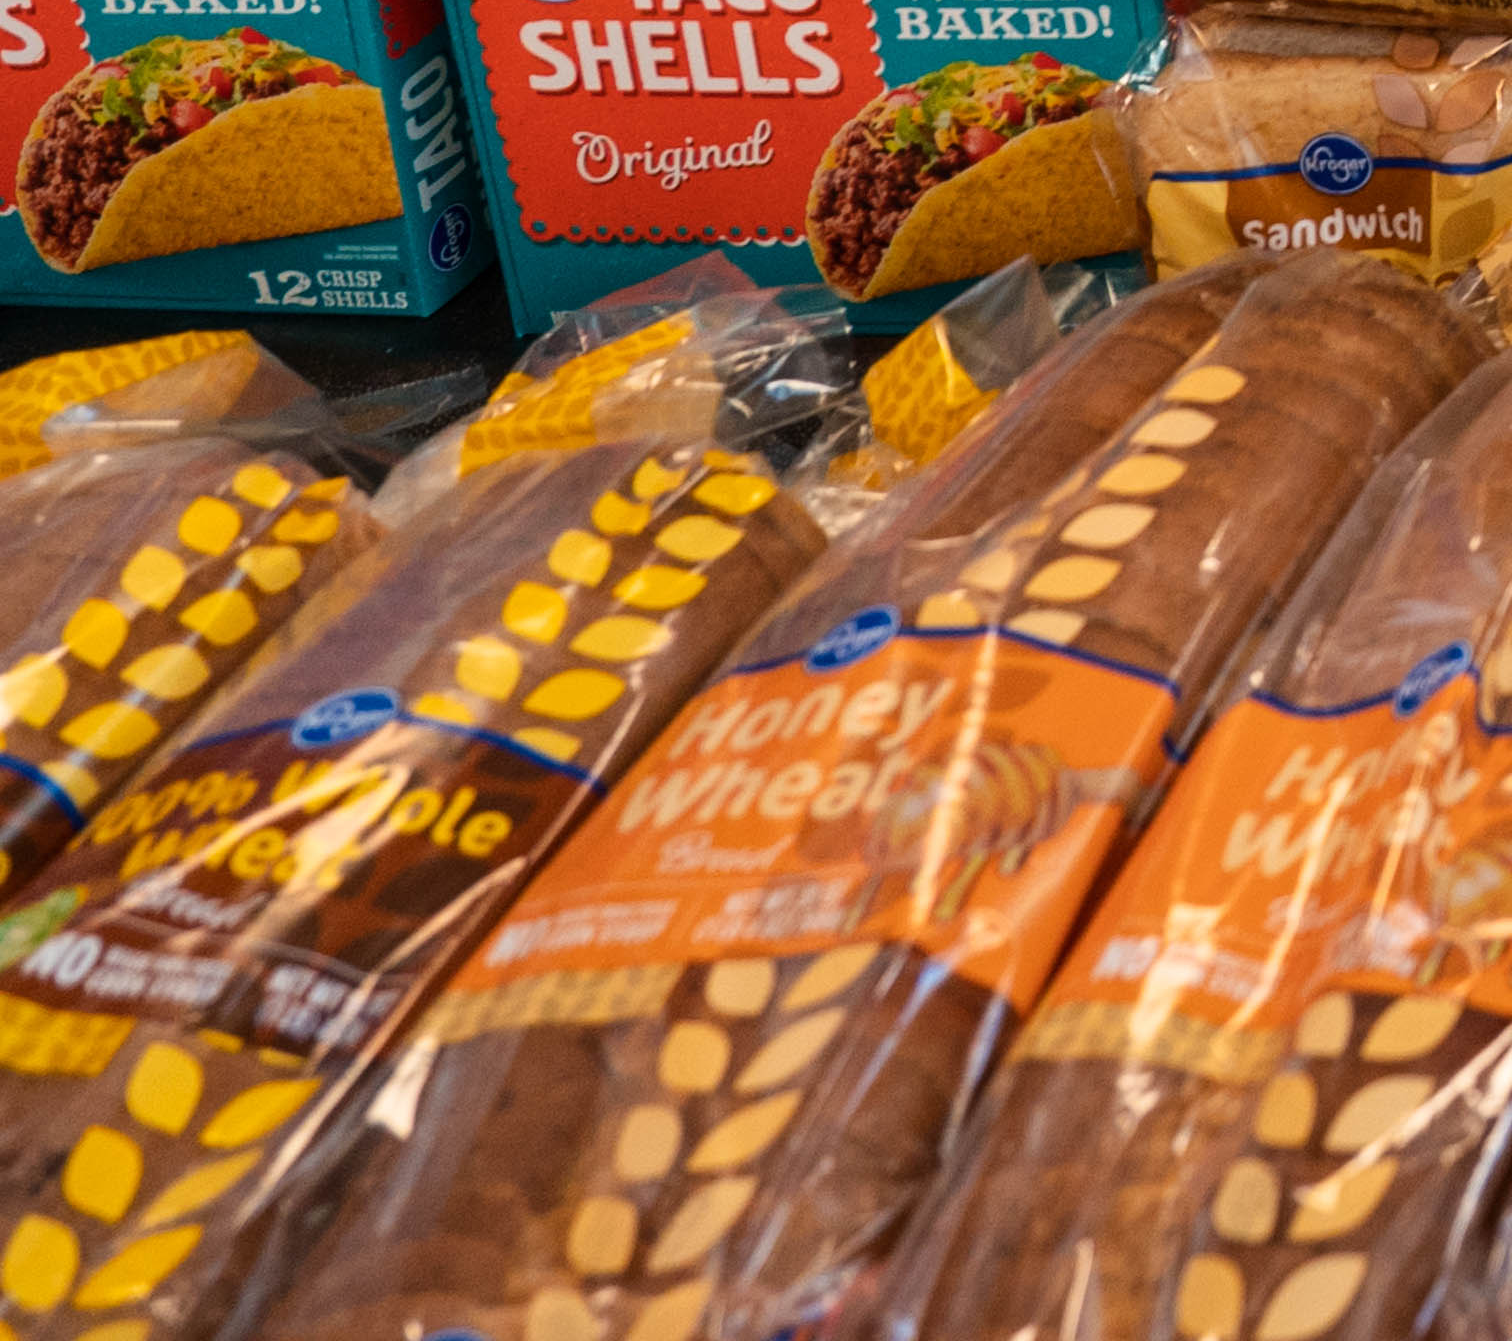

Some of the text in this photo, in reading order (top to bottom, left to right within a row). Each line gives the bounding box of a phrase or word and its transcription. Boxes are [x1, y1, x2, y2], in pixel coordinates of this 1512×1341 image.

[519, 19, 841, 96] SHELLS
[896, 7, 1113, 41] BAKED!
[572, 121, 774, 189] Original
[248, 269, 383, 306] 12 CRISP
[322, 289, 408, 309] SHELLS
[668, 676, 956, 760] Honey
[617, 755, 914, 831] Wheat
